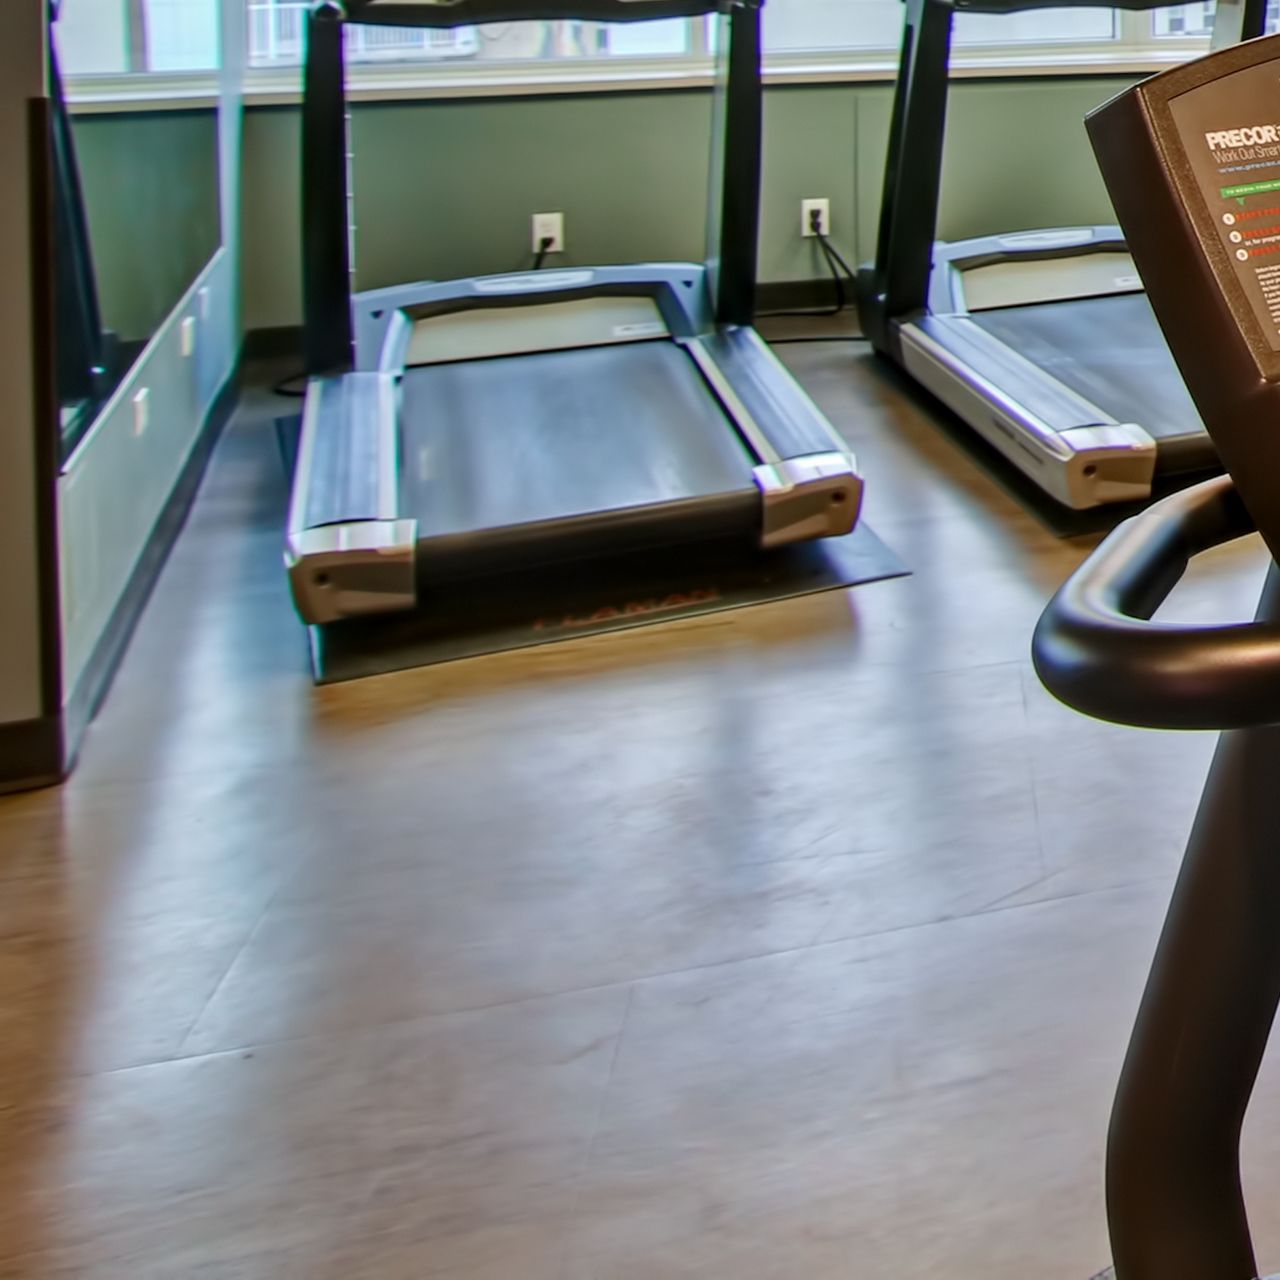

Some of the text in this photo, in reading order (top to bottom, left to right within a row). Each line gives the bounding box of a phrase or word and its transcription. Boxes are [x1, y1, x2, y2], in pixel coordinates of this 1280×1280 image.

[1205, 124, 1278, 150] PRECOR
[1212, 150, 1240, 164] Work
[1240, 147, 1256, 160] Out
